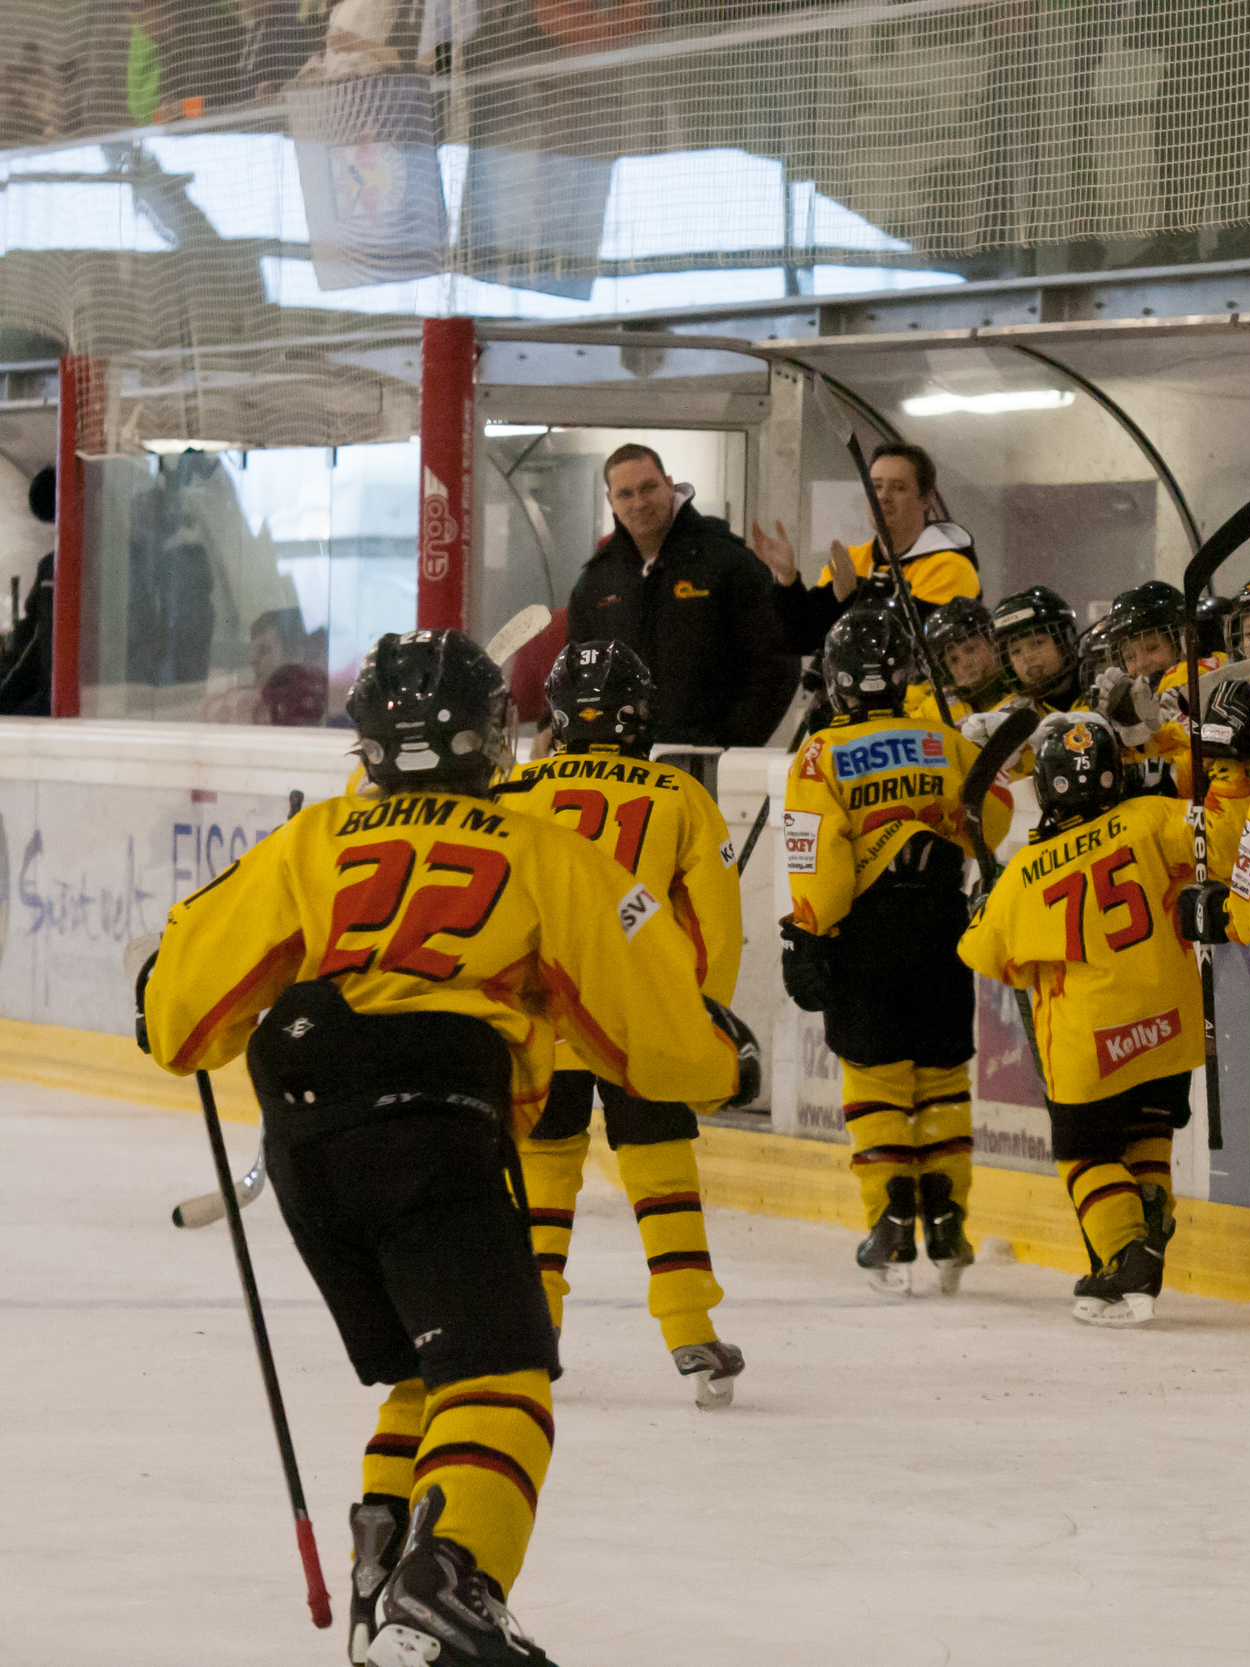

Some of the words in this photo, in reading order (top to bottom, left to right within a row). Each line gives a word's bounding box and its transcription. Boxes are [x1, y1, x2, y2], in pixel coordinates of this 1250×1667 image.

[522, 760, 650, 786] SKOMAR
[654, 774, 680, 791] E.
[836, 738, 919, 777] ERSTE
[1074, 756, 1091, 771] 75
[849, 773, 945, 811] DORNER
[460, 807, 510, 839] M.
[1021, 828, 1102, 888] MÜLLER
[1107, 815, 1127, 839] G.
[318, 839, 512, 983] 22
[1043, 844, 1154, 964] 75
[1106, 1017, 1172, 1062] Kelly's
